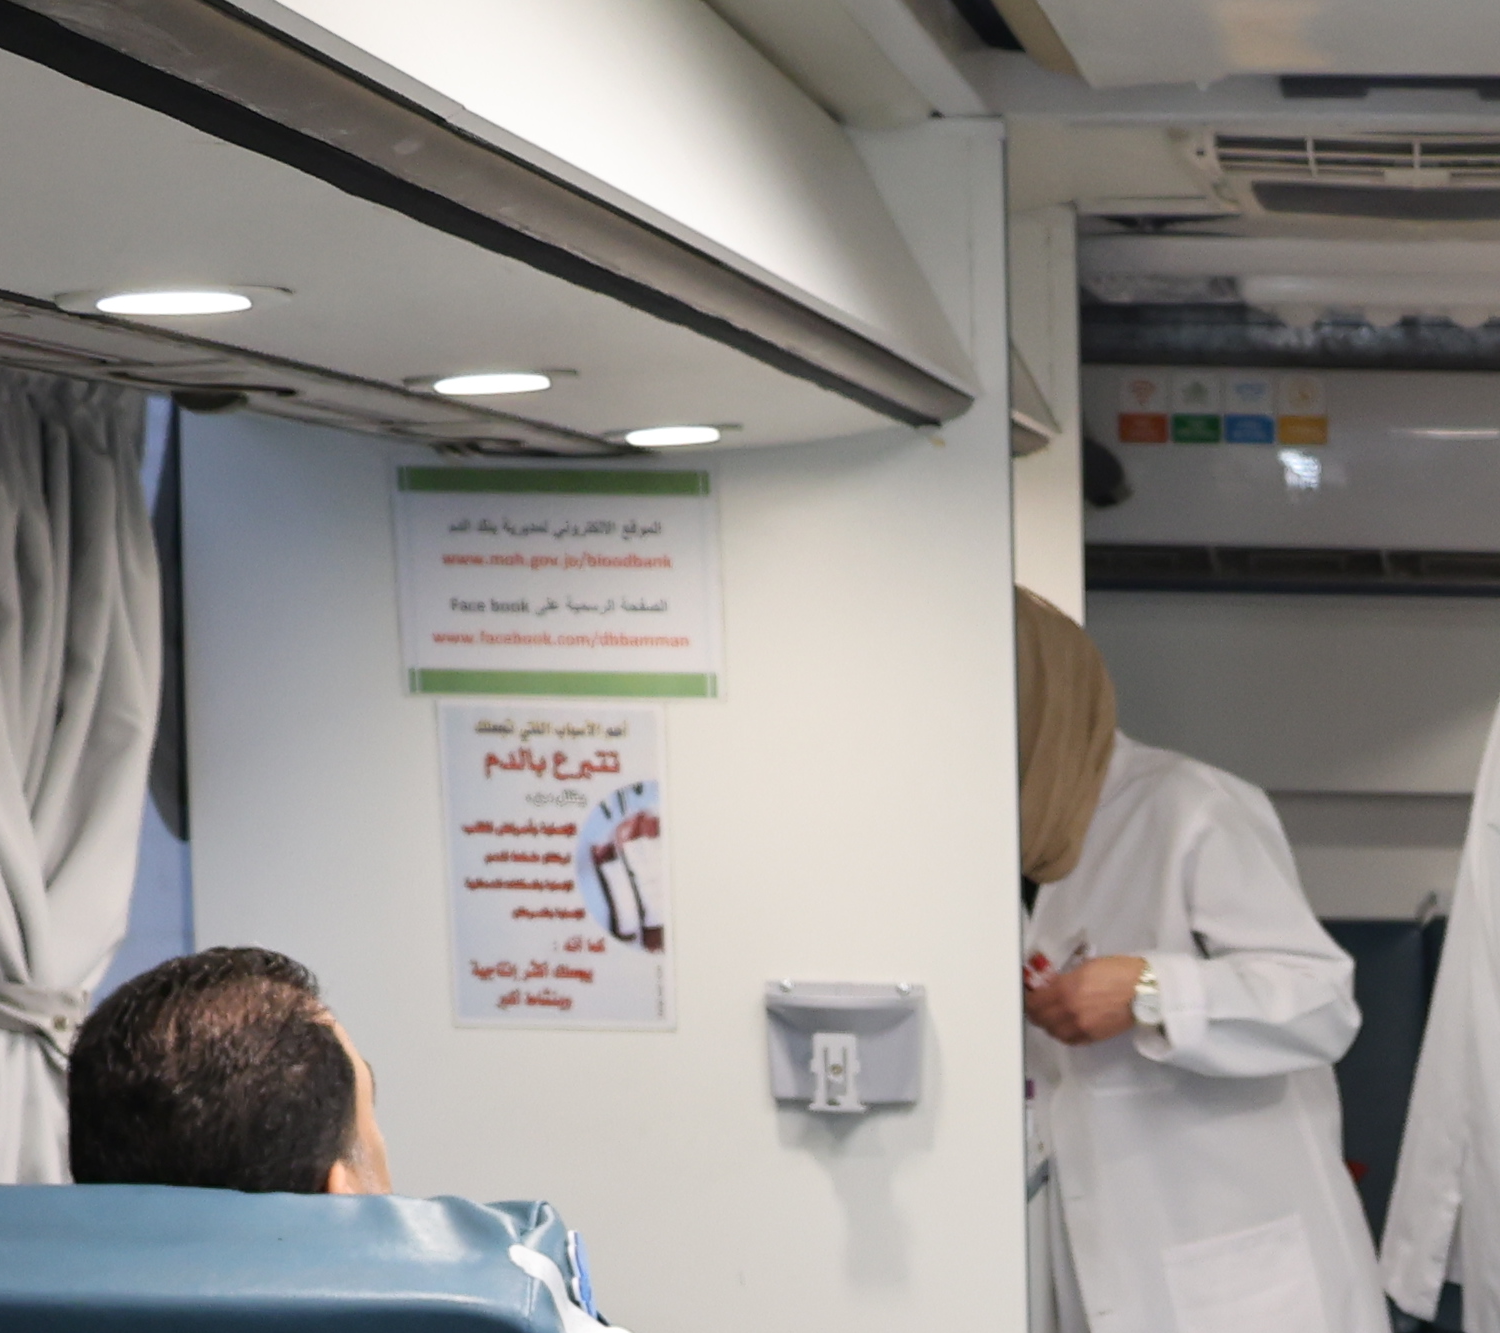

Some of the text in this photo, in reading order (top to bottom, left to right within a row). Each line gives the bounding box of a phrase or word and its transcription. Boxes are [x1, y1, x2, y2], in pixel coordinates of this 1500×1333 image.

[490, 597, 530, 613] book
[485, 747, 620, 780] تتبرع بالدم
